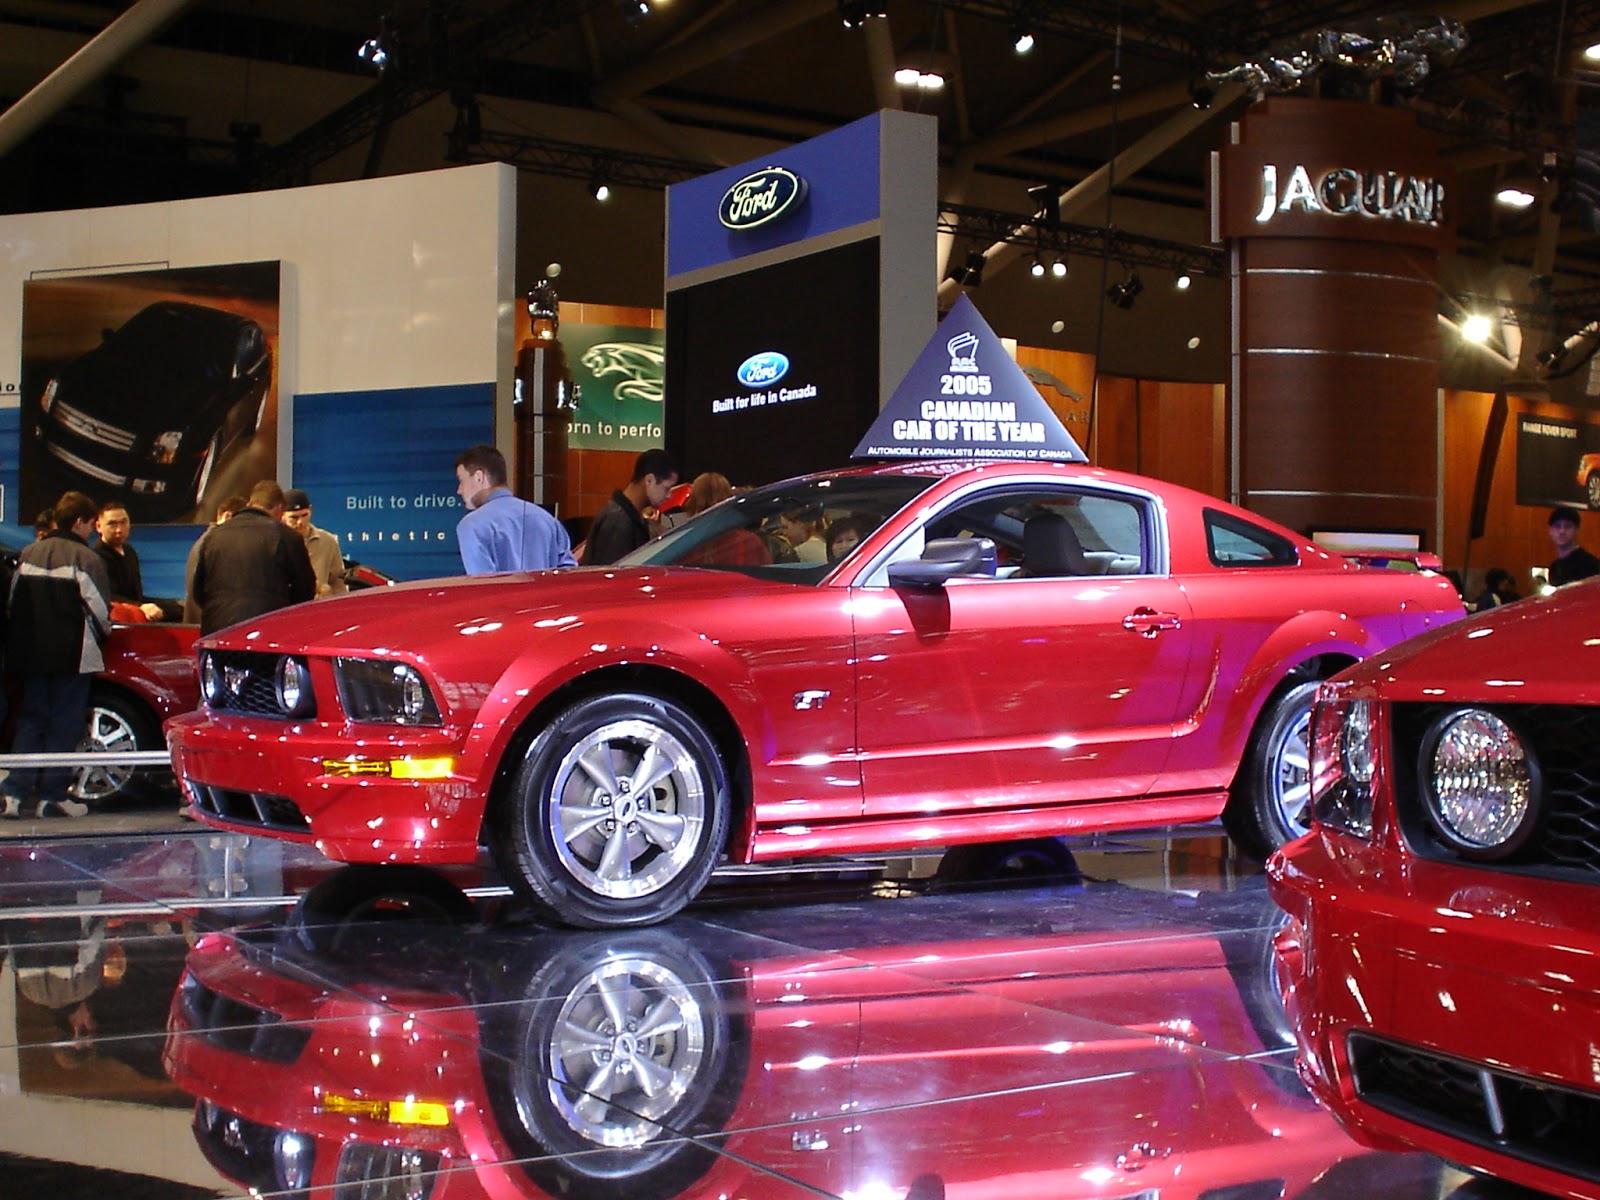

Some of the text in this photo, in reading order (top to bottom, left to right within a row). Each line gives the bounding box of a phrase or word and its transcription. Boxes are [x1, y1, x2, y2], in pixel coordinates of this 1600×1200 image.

[729, 177, 779, 221] Ford
[1255, 165, 1444, 227] JAGUAR
[746, 358, 779, 382] Ford
[940, 374, 992, 395] 2005
[712, 384, 817, 413] Built for life in Canada
[921, 400, 1016, 421] CANADIAN
[598, 421, 612, 435] to
[893, 420, 1045, 442] CAR OF THE YEAR
[868, 446, 1073, 459] AUTOMOBILE JOURNALISTS ASSOCIATION OF CANADA
[346, 494, 461, 509] Built to drive.
